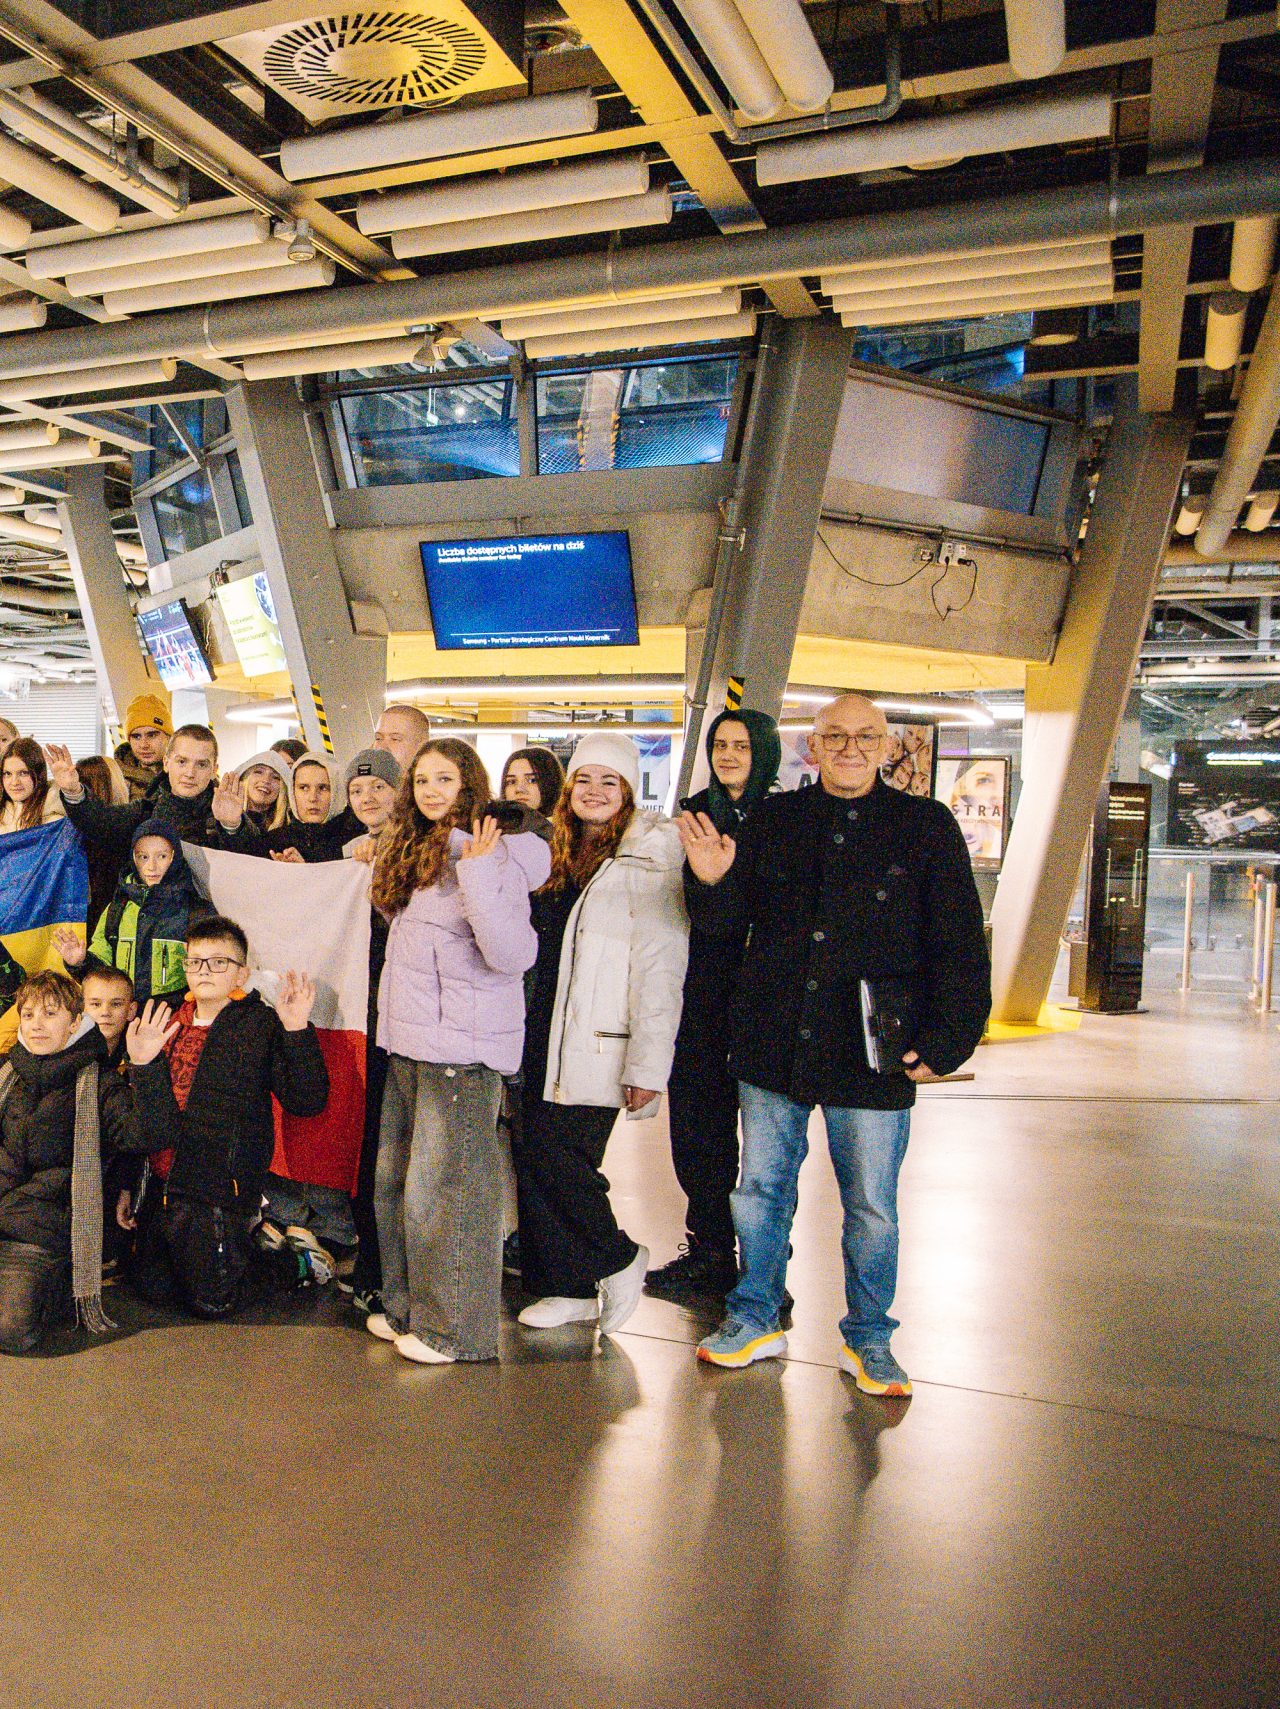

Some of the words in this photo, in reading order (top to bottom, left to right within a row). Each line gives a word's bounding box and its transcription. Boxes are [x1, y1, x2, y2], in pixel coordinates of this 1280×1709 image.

[438, 547, 465, 557] Liczba
[466, 544, 518, 556] dostępnych
[518, 542, 552, 553] biletów
[553, 543, 565, 551] na
